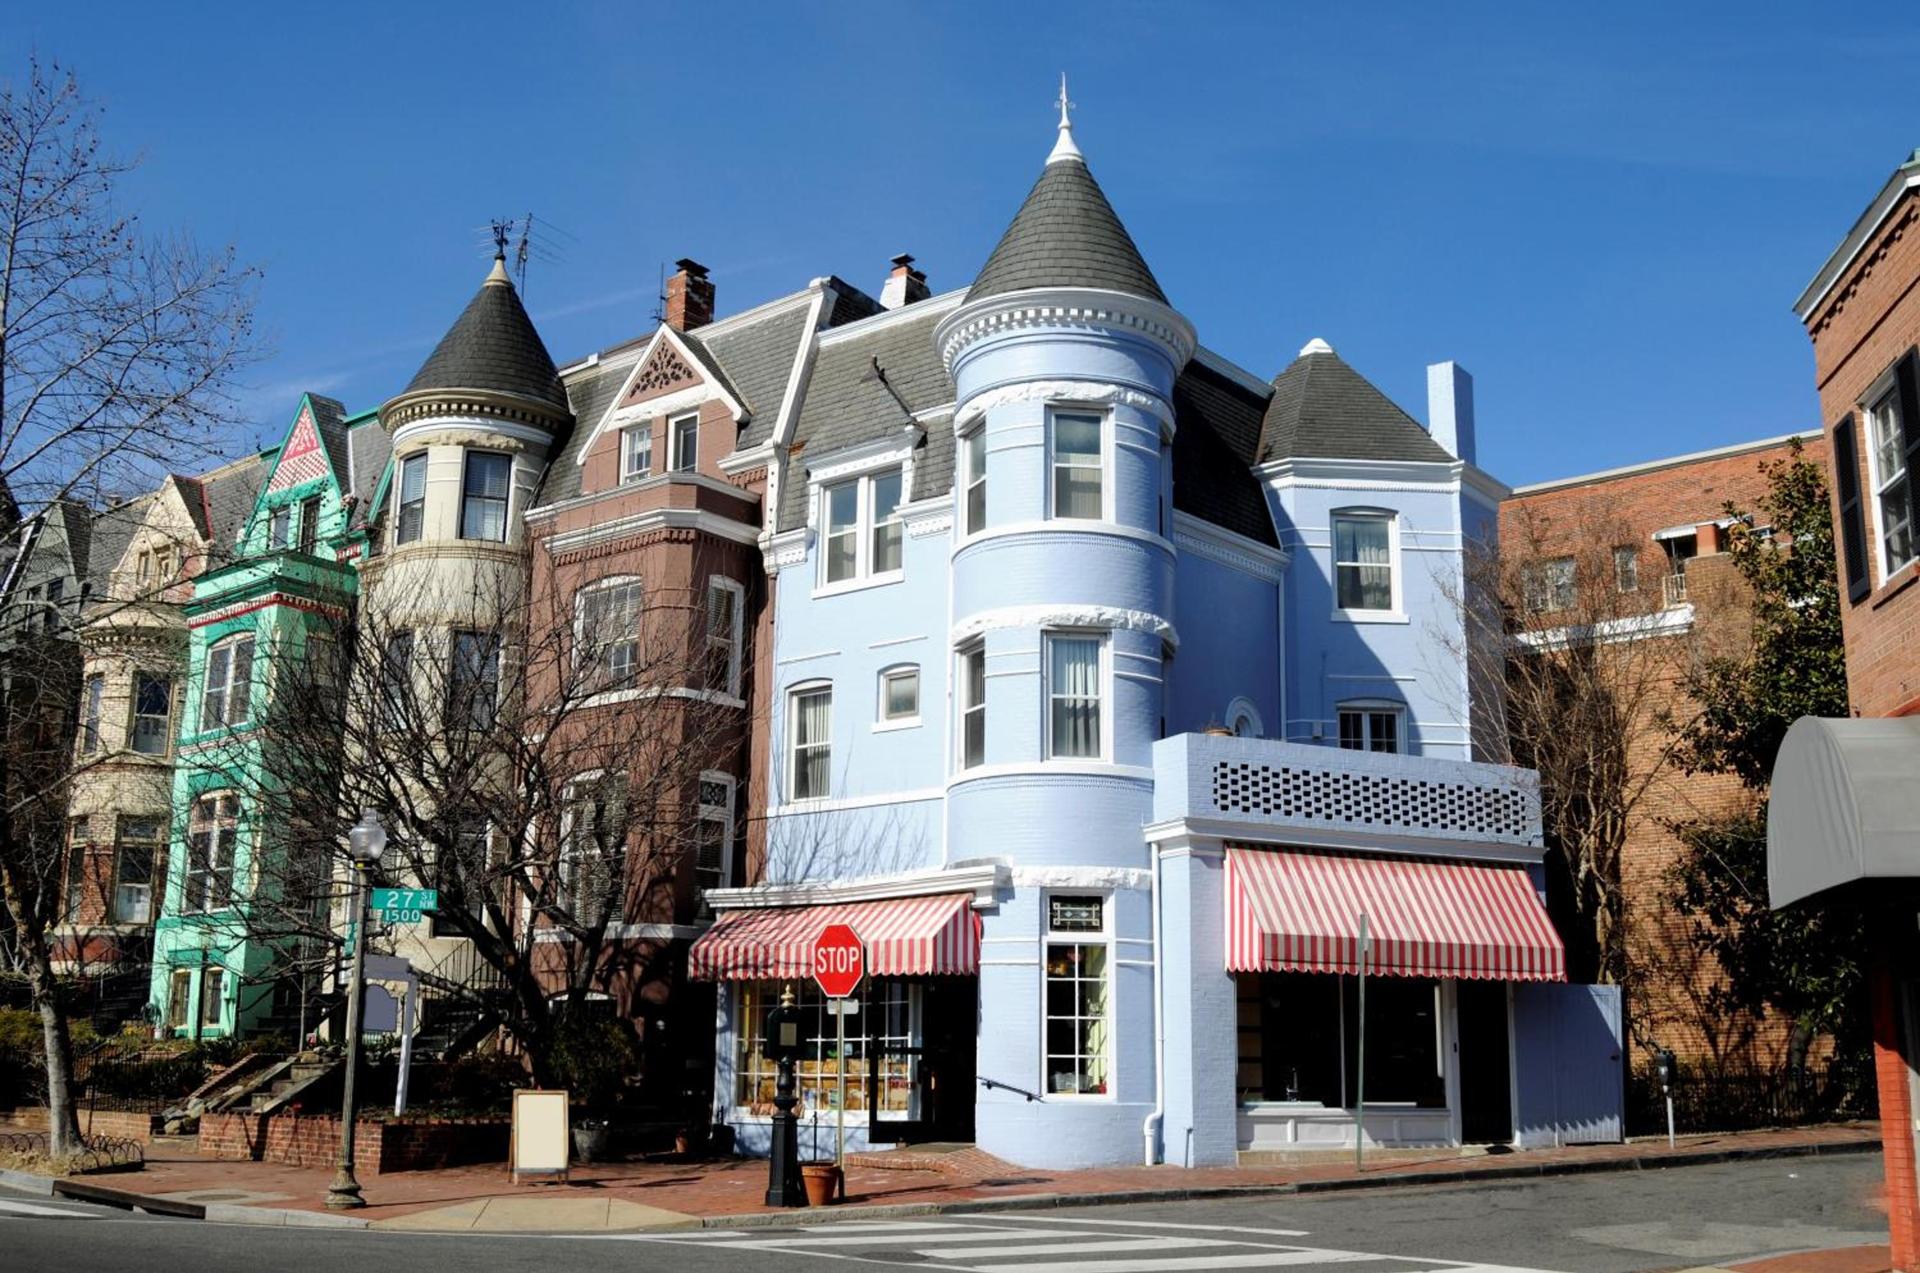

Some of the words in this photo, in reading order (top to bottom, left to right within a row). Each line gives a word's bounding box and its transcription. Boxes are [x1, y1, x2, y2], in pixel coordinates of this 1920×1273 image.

[387, 890, 414, 908] 27
[421, 891, 433, 900] ST
[420, 901, 433, 909] NW
[385, 909, 420, 921] 1500
[817, 947, 860, 973] STOP
